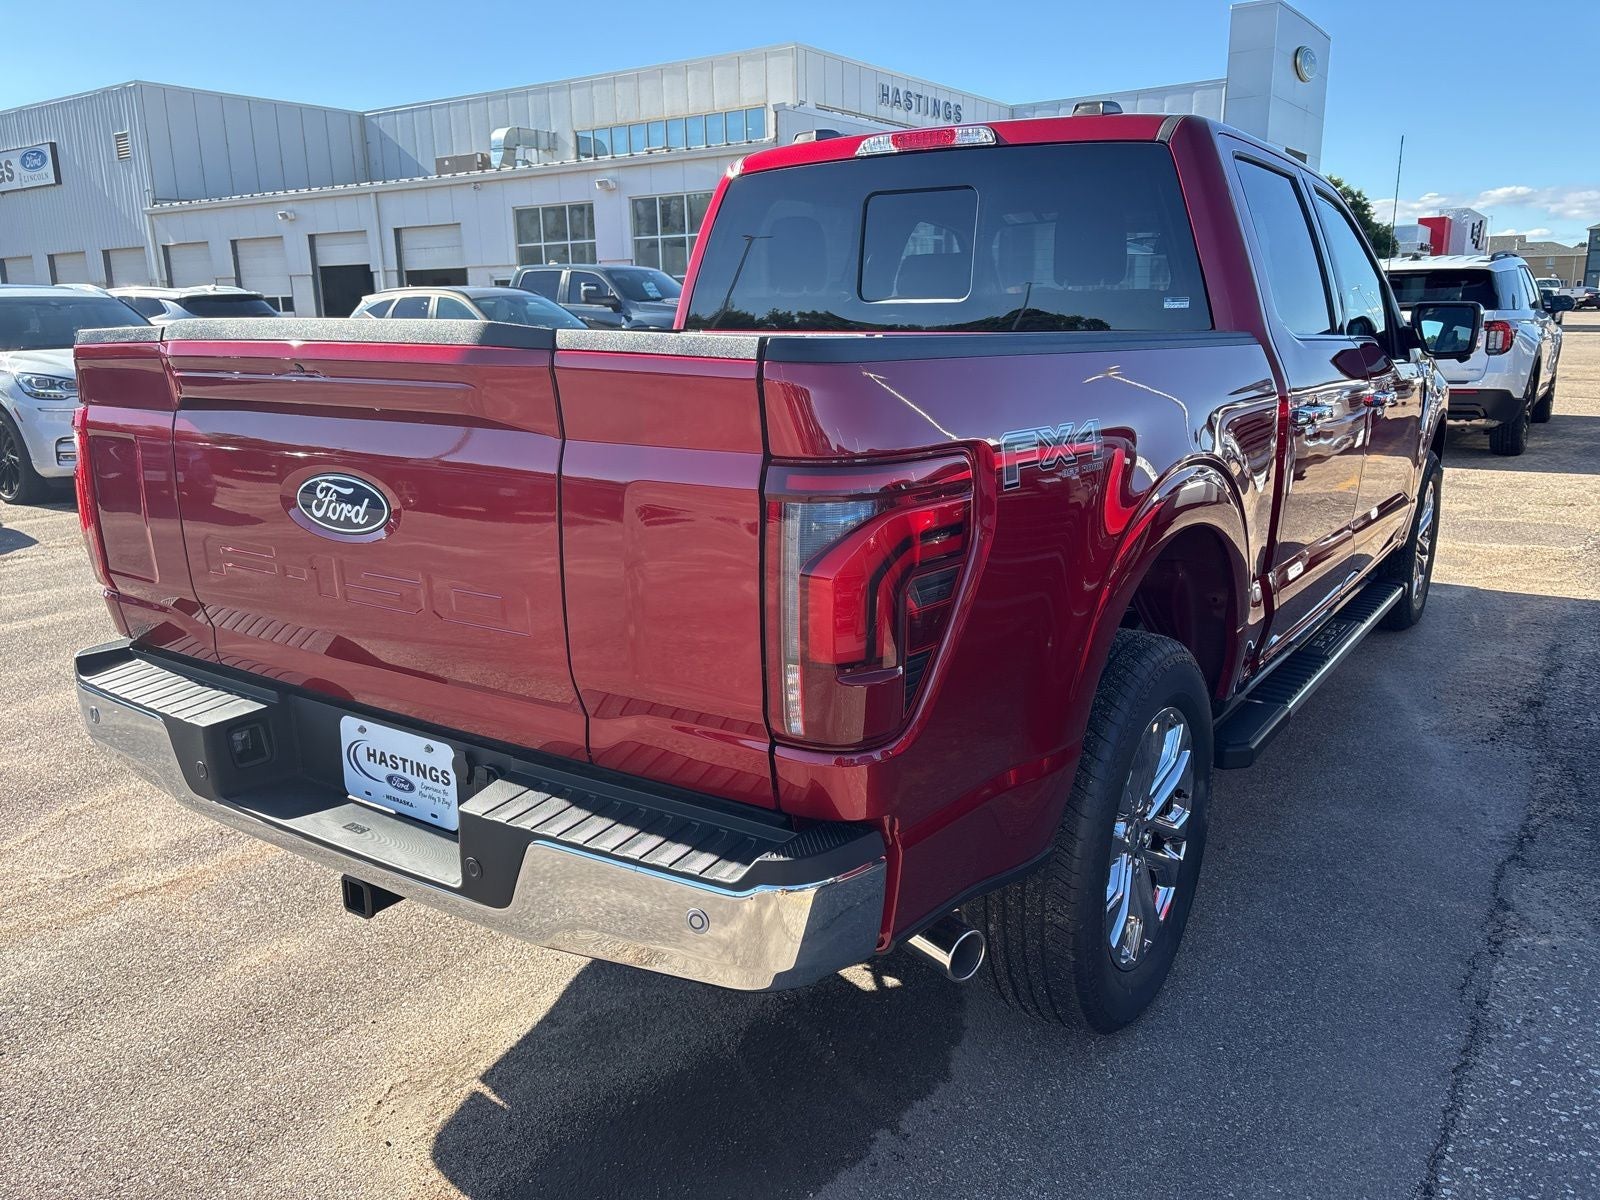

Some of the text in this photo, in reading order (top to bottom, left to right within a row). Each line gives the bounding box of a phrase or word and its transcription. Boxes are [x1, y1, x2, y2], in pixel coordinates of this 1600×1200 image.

[880, 82, 963, 122] HASTINGS
[23, 172, 49, 183] LINCOLN
[1000, 418, 1104, 491] FX4
[312, 482, 369, 525] Ford
[203, 534, 532, 637] F-150
[366, 746, 451, 787] HASTINGS
[385, 794, 414, 808] NEBRASKA
